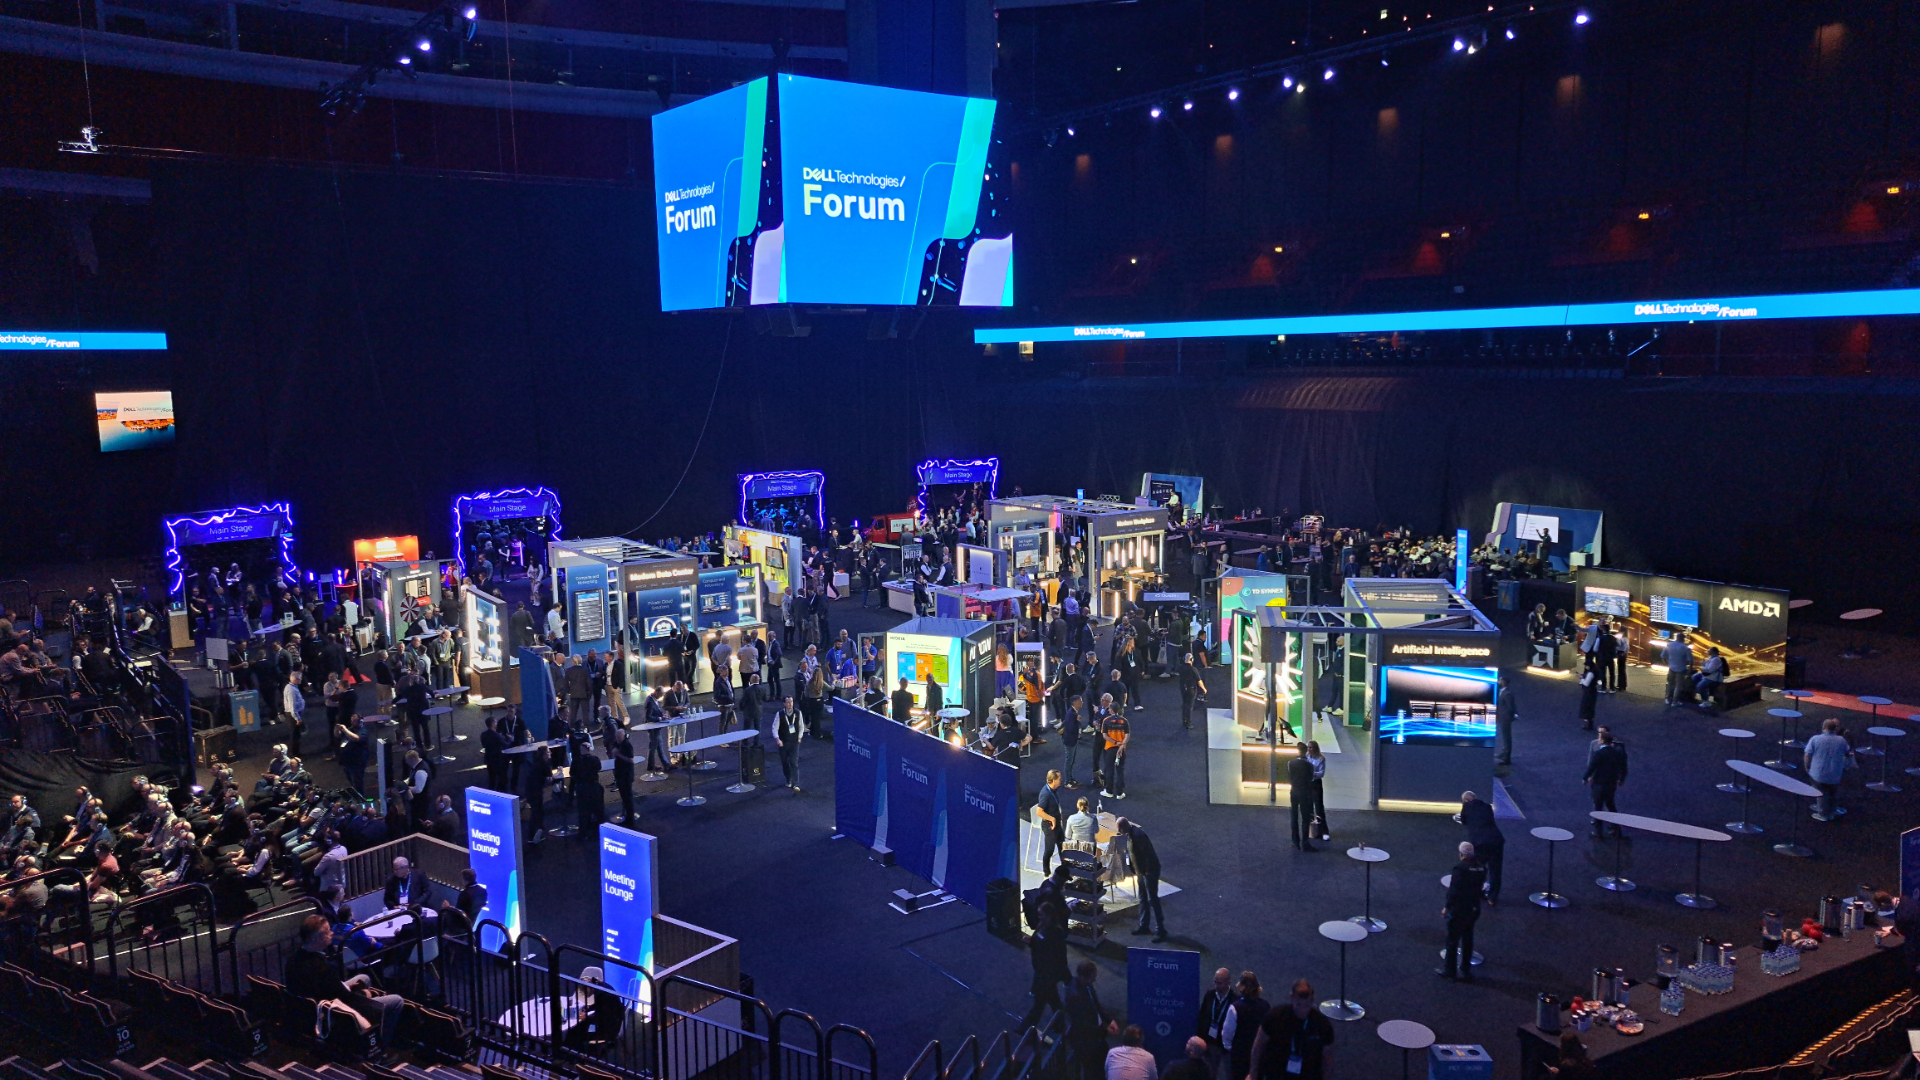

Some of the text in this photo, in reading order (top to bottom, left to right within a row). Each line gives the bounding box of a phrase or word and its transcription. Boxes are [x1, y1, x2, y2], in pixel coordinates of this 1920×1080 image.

[804, 183, 905, 221] Forum
[666, 205, 716, 234] Forum
[0, 334, 47, 345] echnologies
[507, 504, 527, 512] Stage
[209, 525, 253, 535] Main Stage
[1718, 597, 1764, 615] AMD
[1392, 644, 1491, 657] Artificial Intelligence
[847, 738, 871, 759] Forum
[902, 763, 928, 785] Forum
[965, 789, 995, 814] Forum
[470, 803, 491, 815] Forum
[471, 828, 500, 846] Meeting
[472, 841, 499, 857] Lounge
[604, 841, 627, 856] Forum
[604, 868, 636, 890] Meeting
[605, 882, 634, 902] Lounge
[1147, 960, 1179, 970] Forum
[1156, 988, 1171, 996] Exit
[1143, 998, 1185, 1007] Wardrobe
[1153, 1007, 1175, 1017] Toilet
[117, 1029, 130, 1041] 10
[254, 1033, 261, 1043] 9
[370, 1037, 377, 1046] 8
